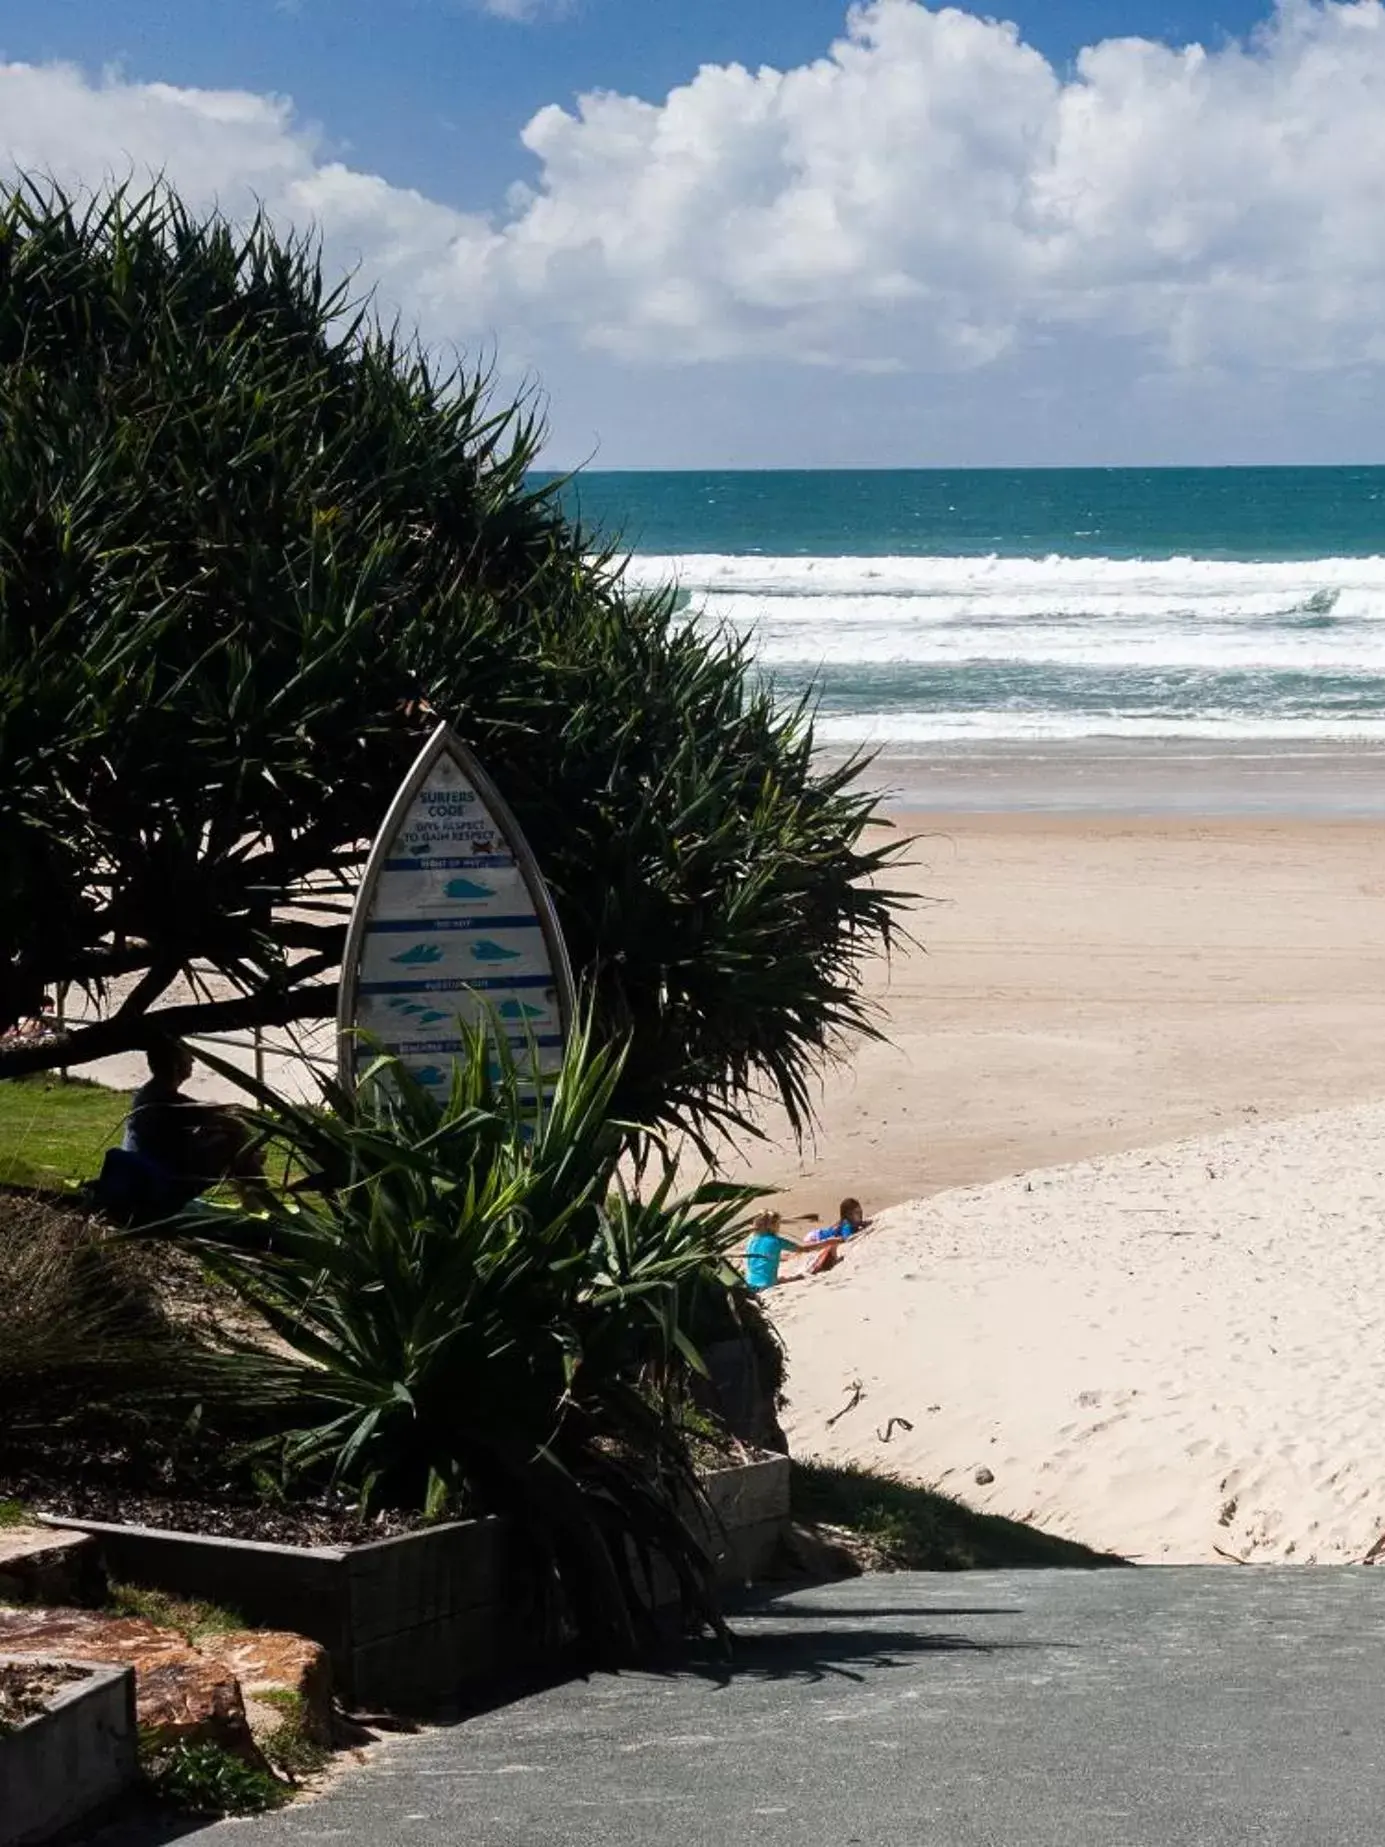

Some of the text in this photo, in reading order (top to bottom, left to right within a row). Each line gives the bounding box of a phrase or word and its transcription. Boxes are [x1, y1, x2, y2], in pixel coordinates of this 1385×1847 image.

[420, 790, 475, 803] SURFERS
[427, 805, 464, 817] CODE
[452, 830, 495, 841] RESPECT
